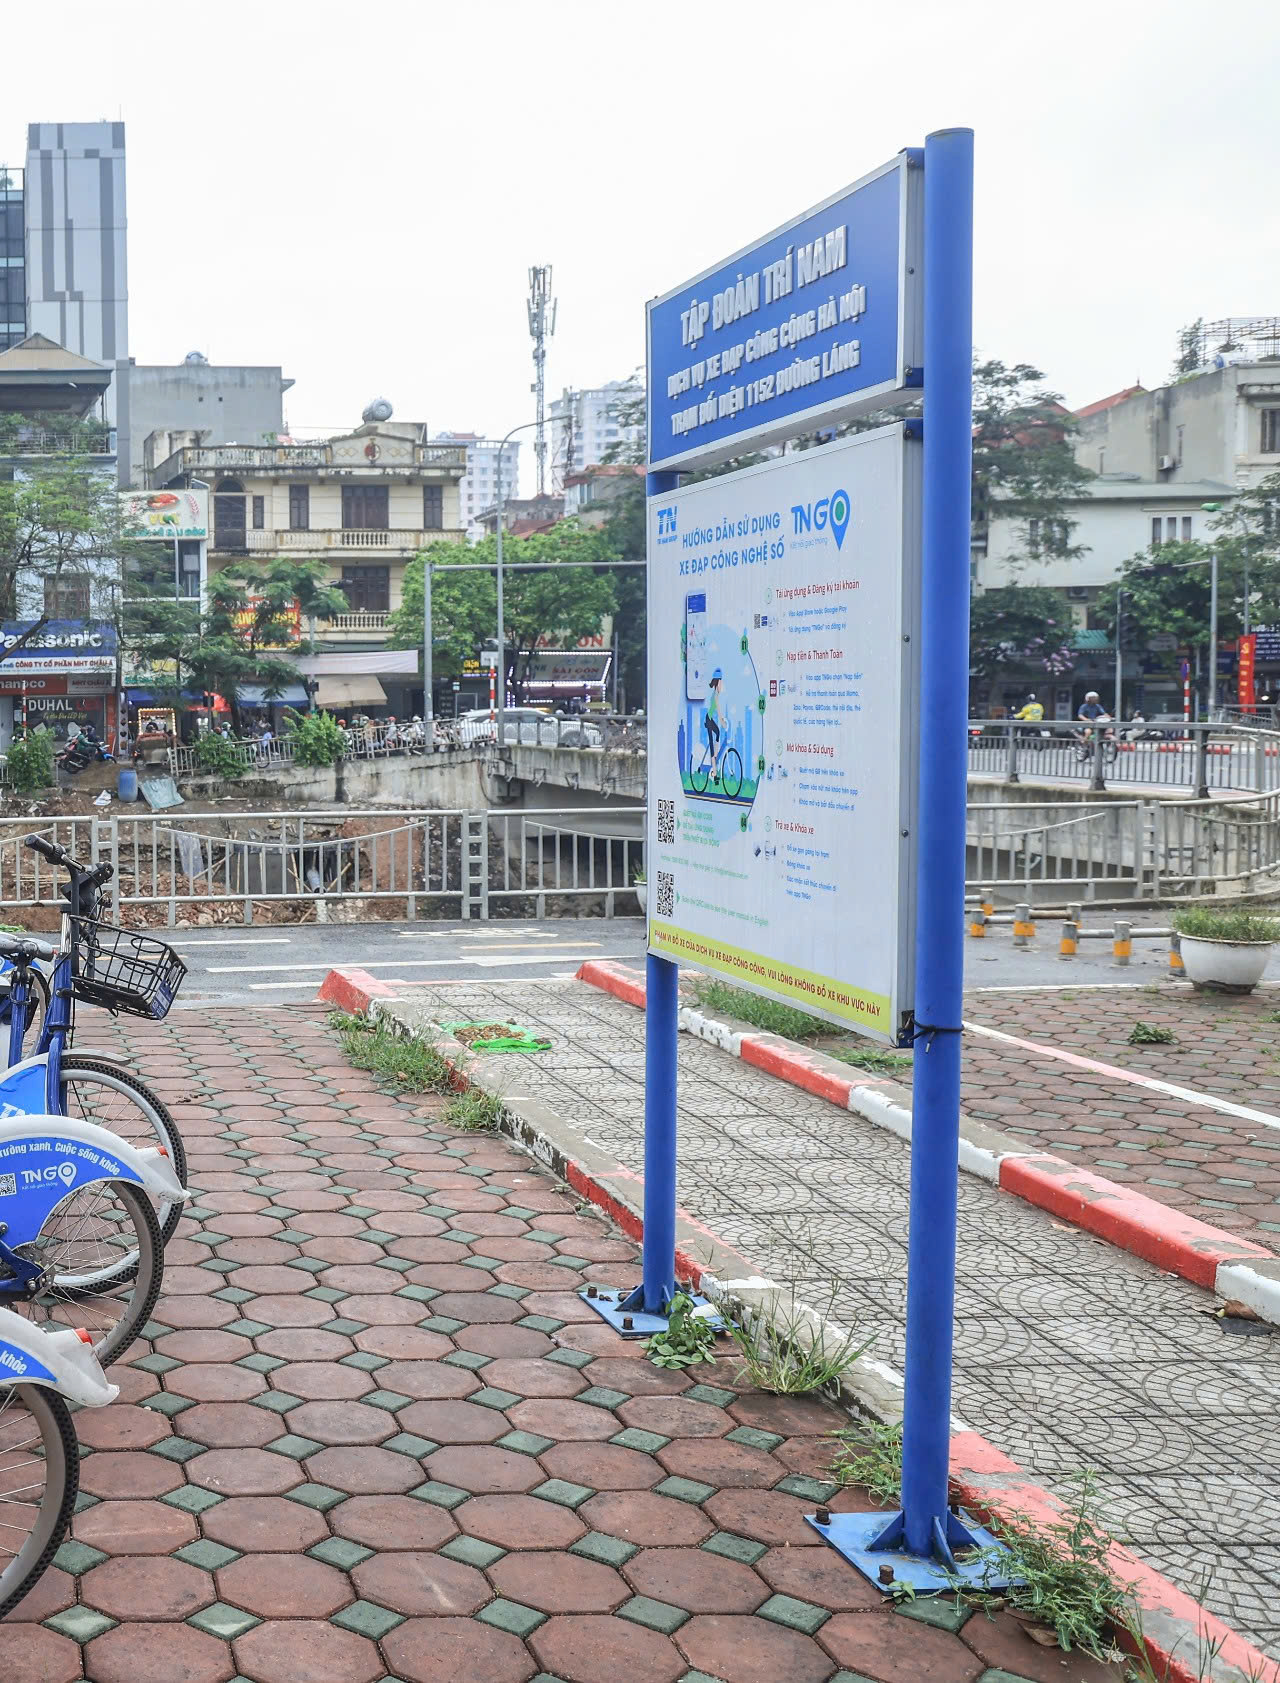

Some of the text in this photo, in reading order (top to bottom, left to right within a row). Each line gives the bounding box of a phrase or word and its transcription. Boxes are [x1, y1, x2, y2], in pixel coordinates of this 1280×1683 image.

[680, 224, 847, 350] TẬP ĐOÀN TRÍ NAM
[667, 283, 866, 400] DỊCH VỤ XE ĐẠP CÔNG CỘNG HÀ NỘI
[671, 405, 698, 436] TRẠM
[746, 375, 776, 407] 1152
[776, 357, 821, 396] ĐƯỜNG
[822, 339, 860, 379] LÁNG
[682, 512, 780, 549] HƯỚNG DẪN SỬ DỤNG
[679, 533, 785, 577] XE ĐẠP CÔNG NGHỆ SỐ
[15, 660, 33, 668] CÔNG
[43, 659, 53, 668] CỔ
[28, 699, 73, 711] DUHAL
[667, 934, 672, 942] VI
[679, 938, 685, 947] XE
[715, 950, 722, 960] XE
[722, 952, 733, 965] ĐẠP
[733, 954, 748, 970] CÔNG
[767, 968, 777, 980] VUI
[777, 969, 793, 986] LÒNG
[794, 976, 816, 993] KHÔNG
[816, 983, 827, 998] ĐỖ
[827, 989, 836, 1000] XE
[836, 992, 850, 1006] KHU
[851, 996, 865, 1013] VỰC
[866, 1000, 881, 1017] NÀY
[21, 1161, 78, 1188] TNGO
[28, 1141, 53, 1152] xanh.
[54, 1142, 77, 1155] Cuộc
[77, 1148, 100, 1164] sống
[99, 1157, 122, 1176] khỏe
